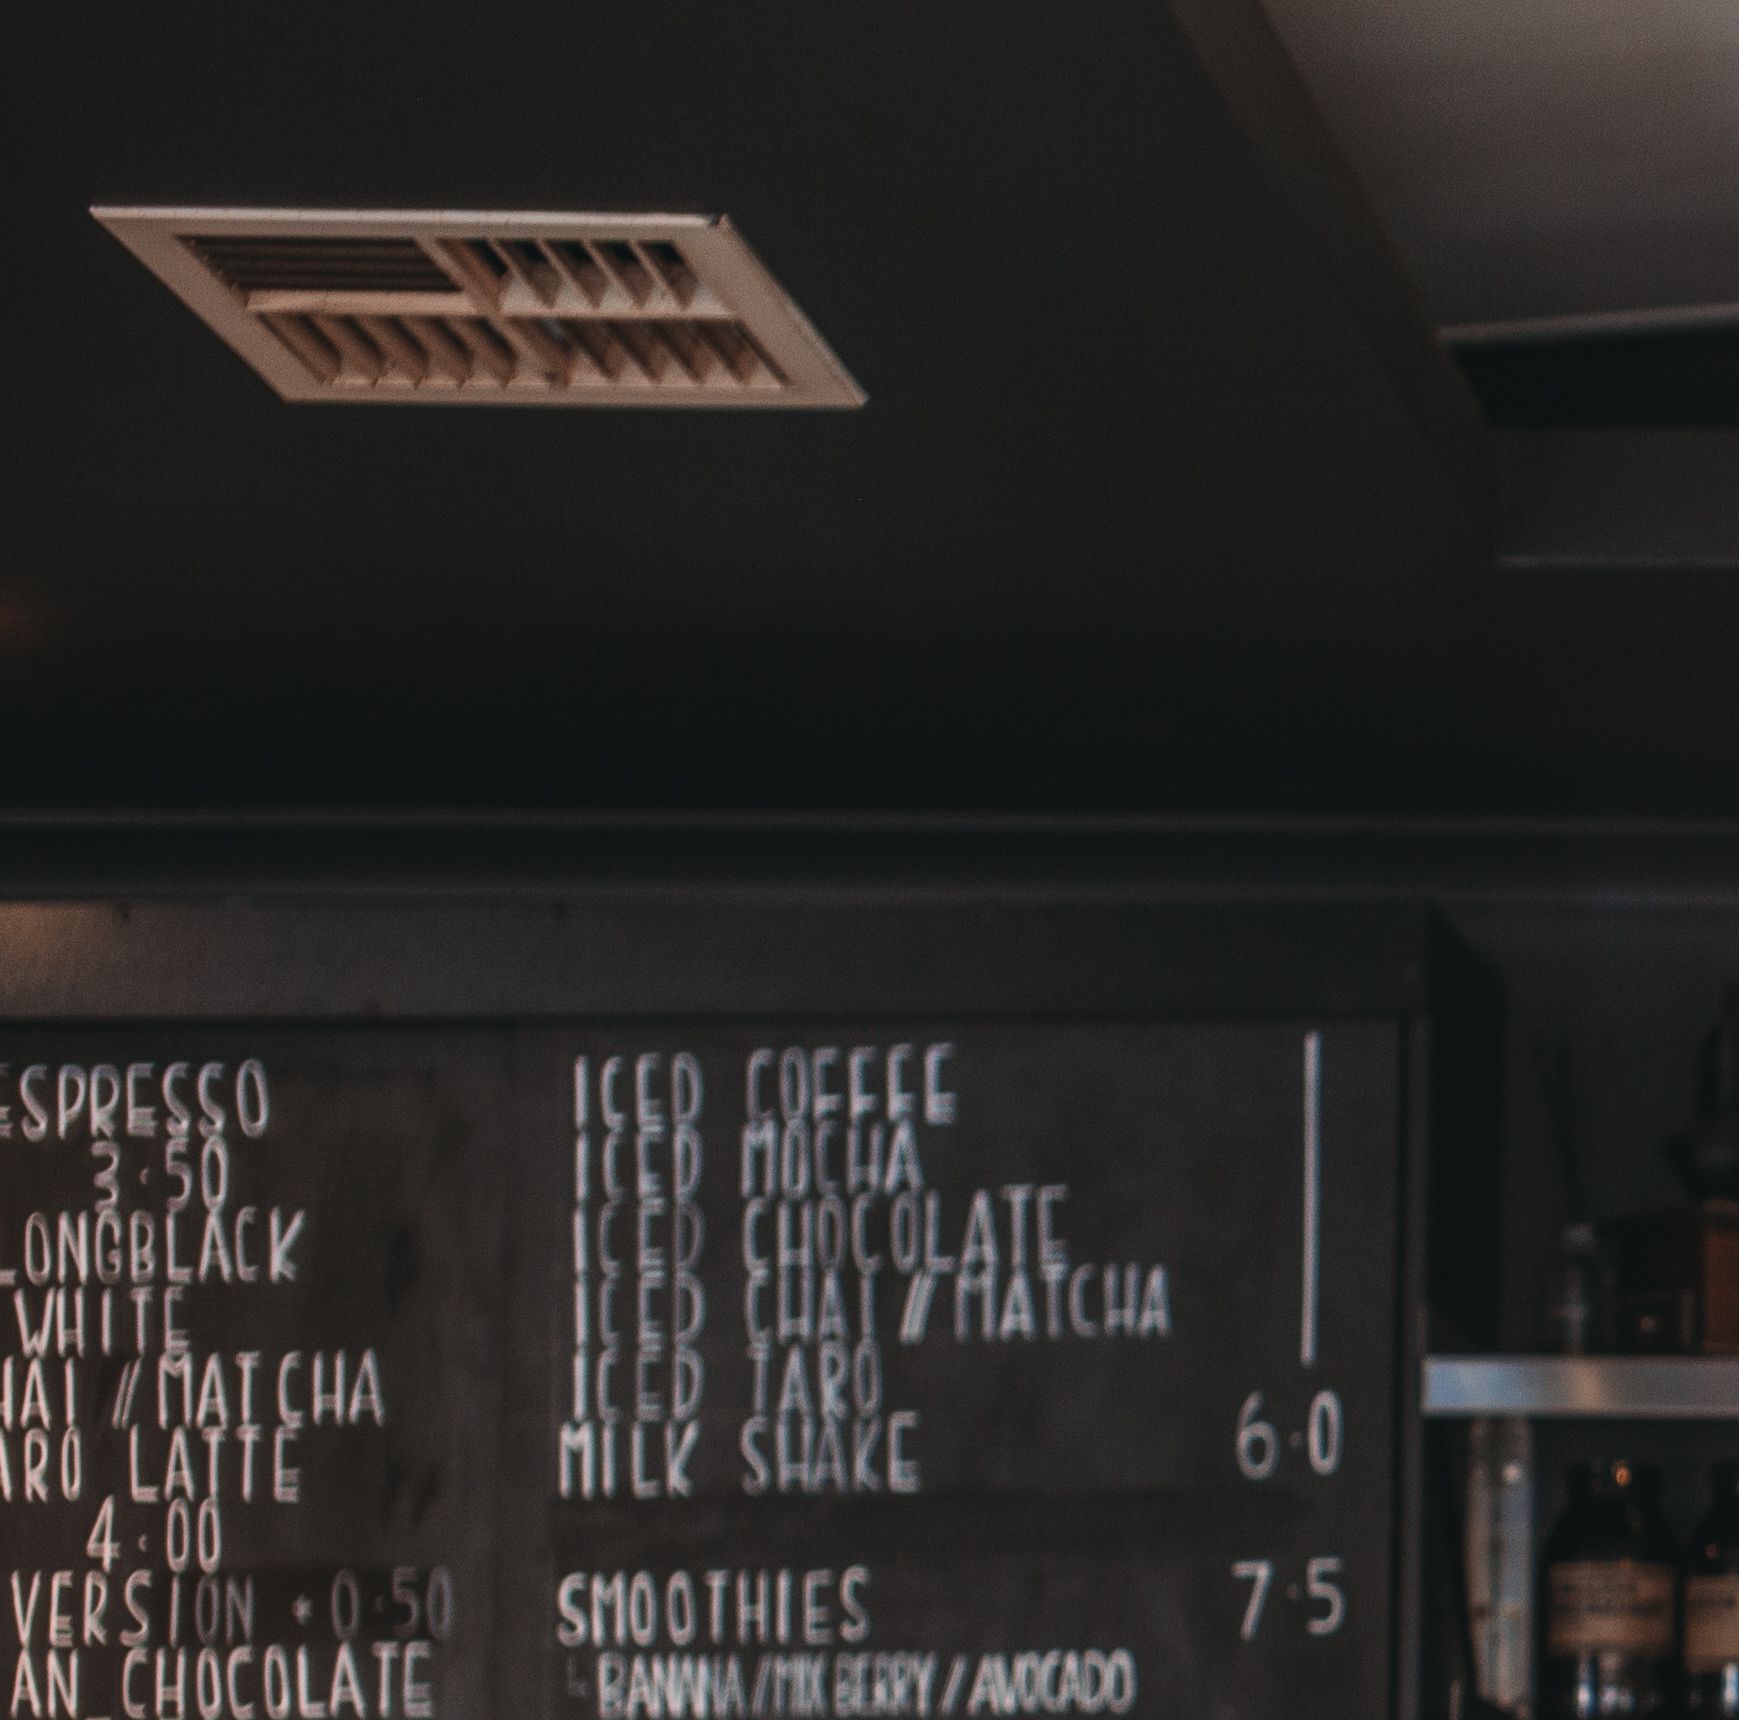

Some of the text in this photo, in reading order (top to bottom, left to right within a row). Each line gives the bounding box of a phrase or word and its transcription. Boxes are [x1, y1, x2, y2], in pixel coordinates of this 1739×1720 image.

[574, 1042, 957, 1132] ICED COFFEE
[574, 1118, 925, 1201] ICED MOCHA
[0, 1206, 305, 1285] ONGBLACK
[573, 1184, 1069, 1277] ICED CHOCOLATE
[14, 1286, 190, 1358] WHITE
[573, 1272, 705, 1348] ICED
[745, 1268, 876, 1348] CHAI
[574, 1341, 883, 1423] ICED TARO
[130, 1423, 300, 1503] LATTE
[560, 1417, 700, 1499] MILK
[739, 1411, 922, 1497] SHAKE
[11, 1568, 253, 1648] VERSION
[556, 1565, 871, 1648] SMOOTHIES
[123, 1641, 434, 1720] CHOCOLATE
